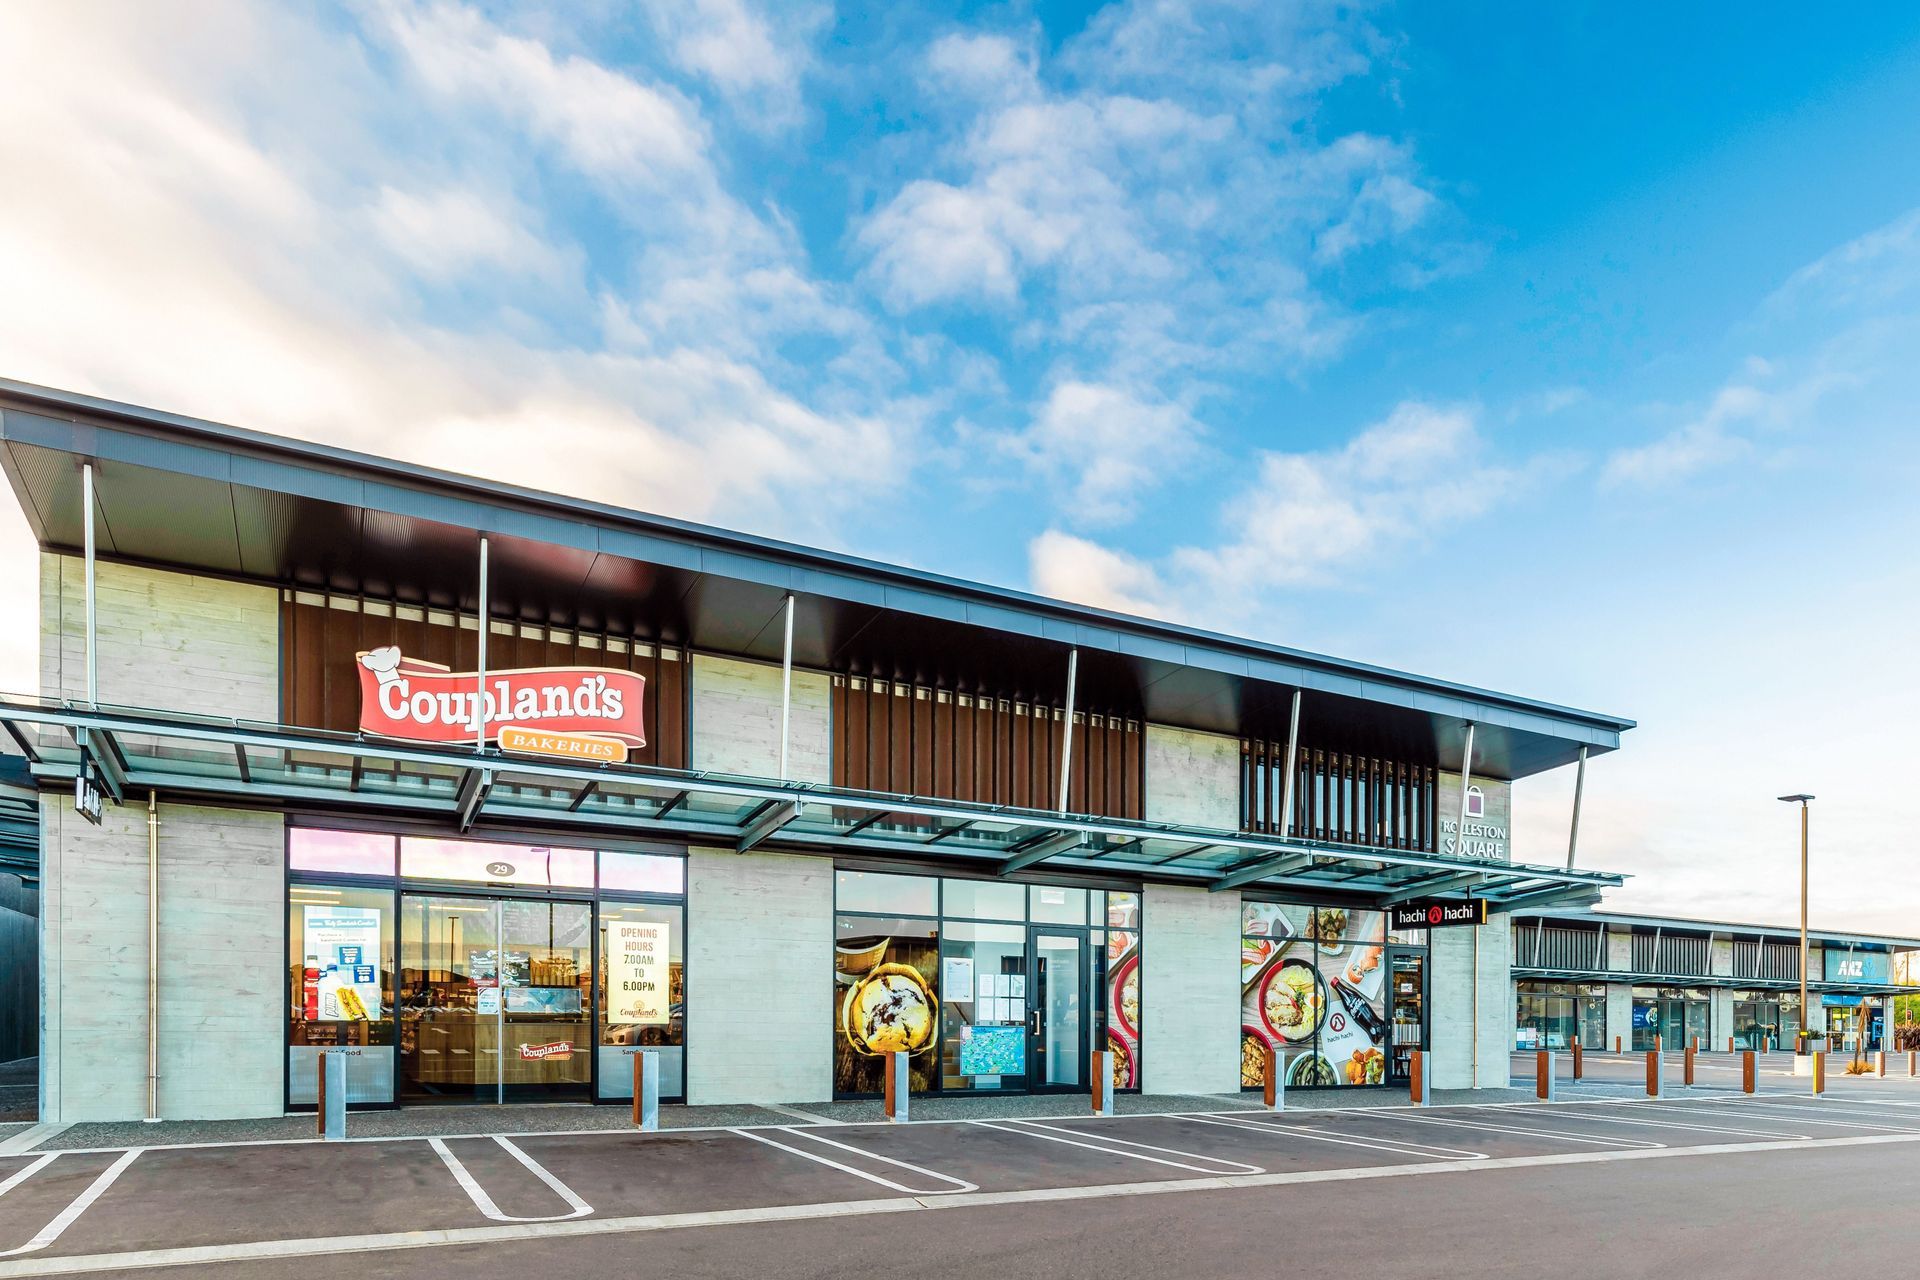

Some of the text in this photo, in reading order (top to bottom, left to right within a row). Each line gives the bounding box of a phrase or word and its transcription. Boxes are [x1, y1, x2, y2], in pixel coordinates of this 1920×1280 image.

[378, 675, 624, 733] Coupland's
[512, 734, 613, 756] BAKERIES
[494, 864, 508, 874] 29
[1400, 905, 1473, 923] hachi hachi
[620, 927, 658, 938] OPENING
[625, 941, 654, 952] HOURS
[623, 954, 655, 965] 7.00AM
[634, 968, 645, 978] TO
[1837, 960, 1863, 977] ANZ
[623, 981, 655, 992] 6.00PM
[523, 1043, 570, 1058] Coupland's
